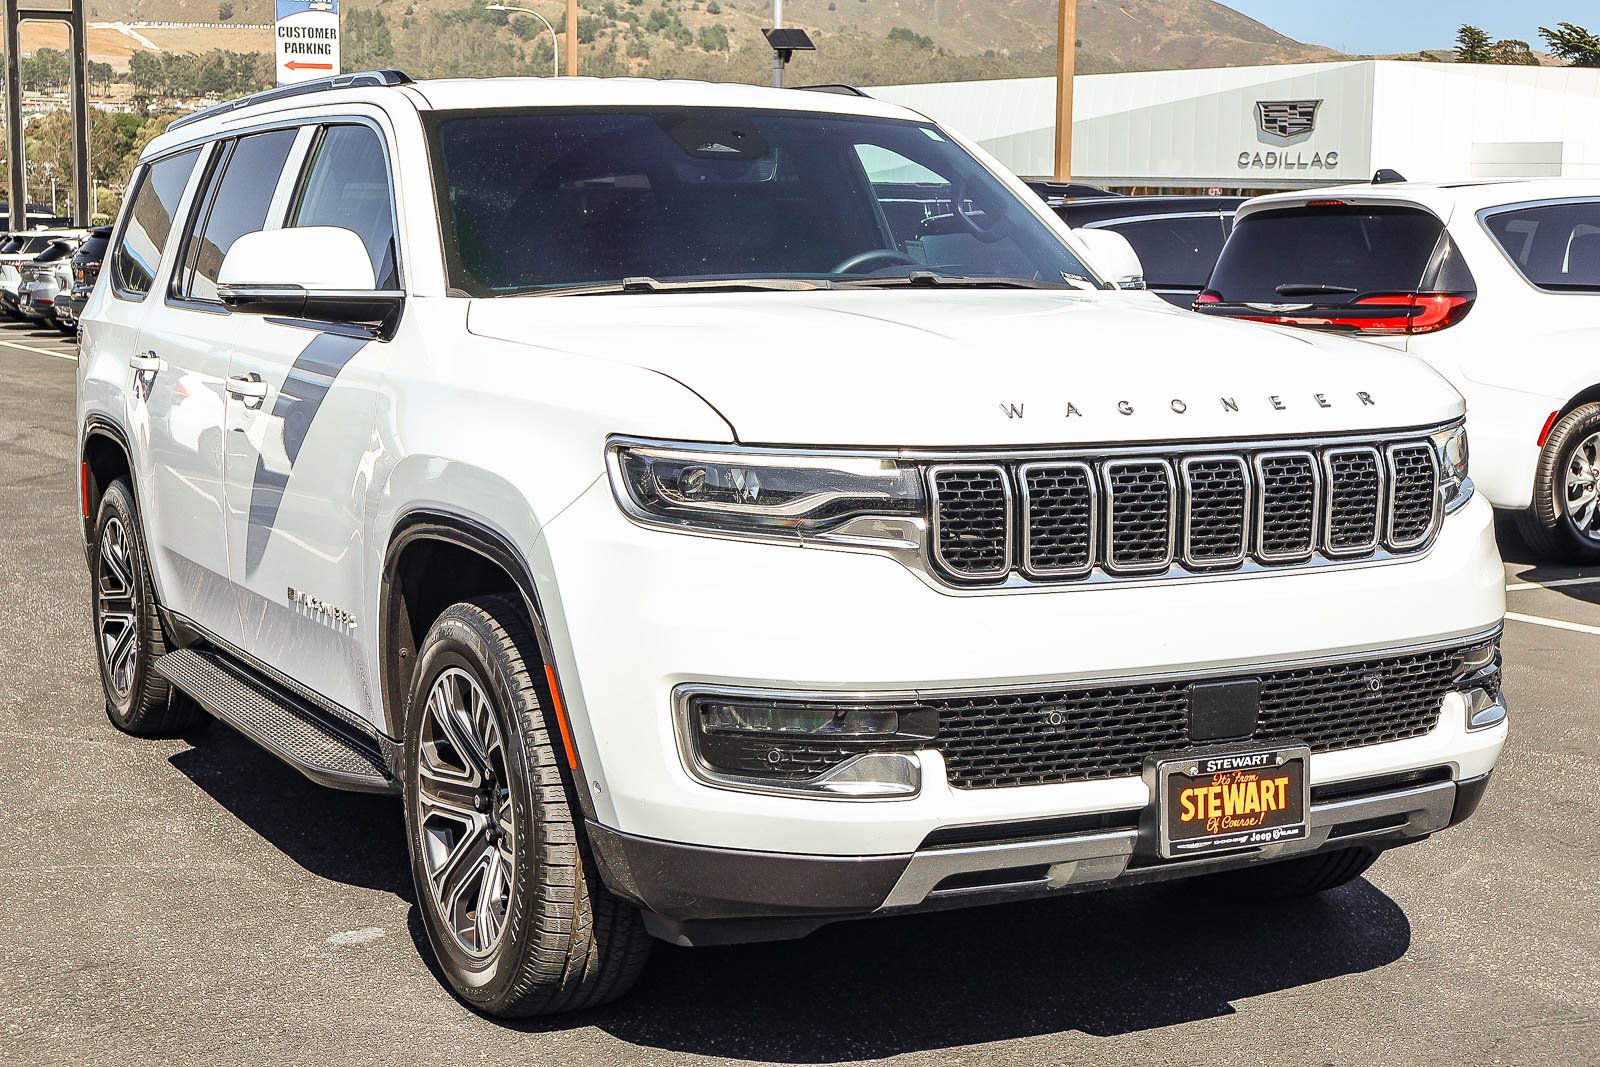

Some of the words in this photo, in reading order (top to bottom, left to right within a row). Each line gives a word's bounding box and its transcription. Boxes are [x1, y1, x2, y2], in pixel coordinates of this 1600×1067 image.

[278, 26, 337, 39] CUSTOMER
[284, 42, 332, 55] PARKING
[1238, 151, 1339, 169] CADILLAC
[999, 390, 1376, 419] WAGONEER
[1206, 754, 1270, 772] STEWART
[1232, 770, 1259, 784] From
[1180, 777, 1289, 822] STEWART
[1206, 816, 1221, 834] Of
[1250, 831, 1272, 843] Jeep
